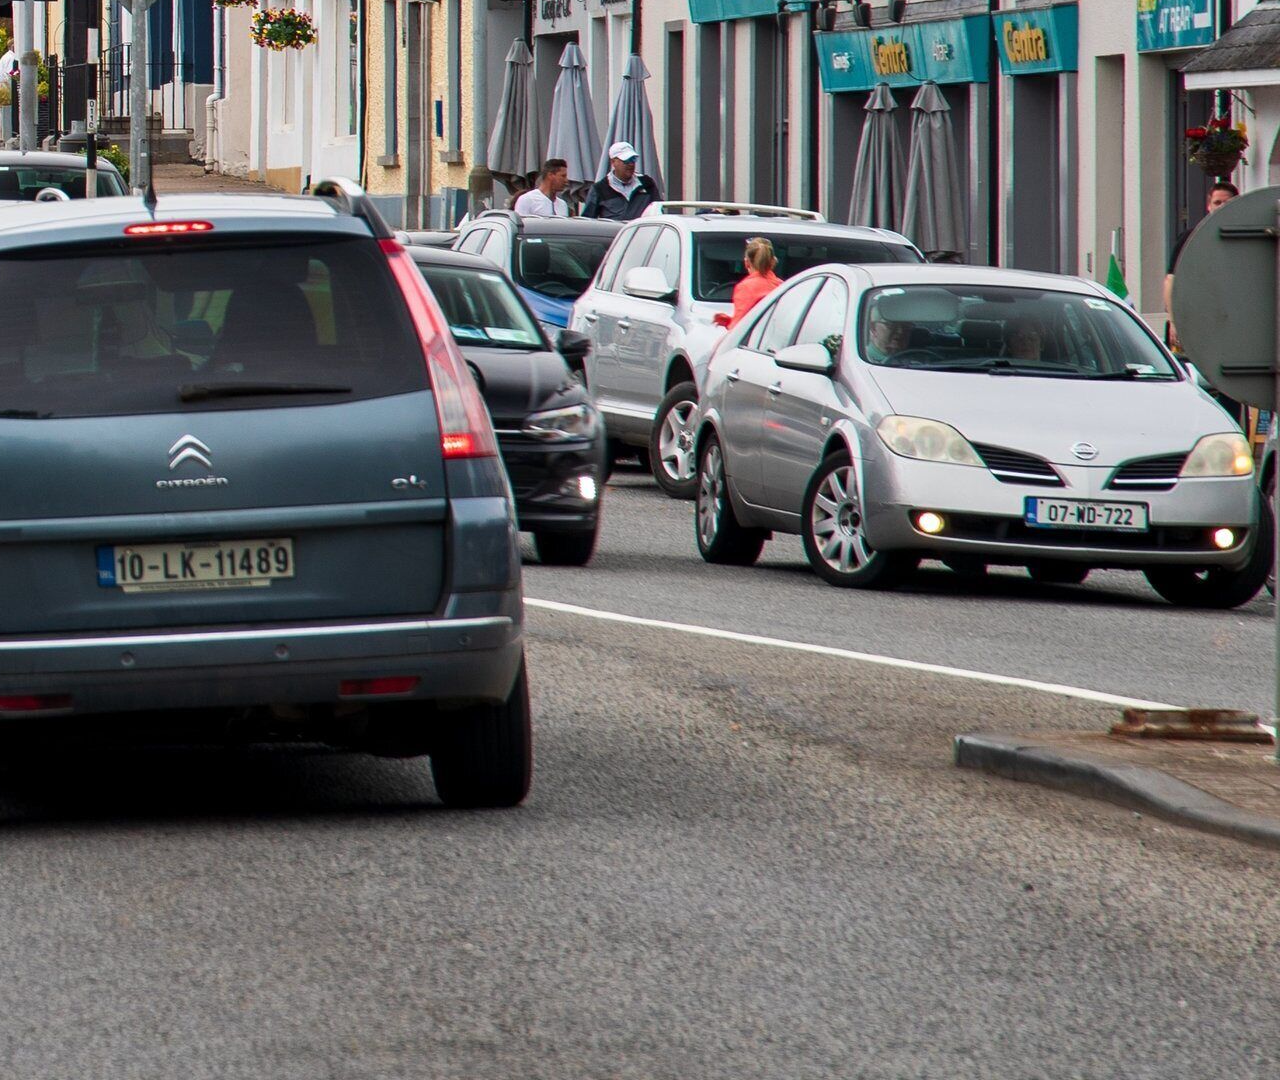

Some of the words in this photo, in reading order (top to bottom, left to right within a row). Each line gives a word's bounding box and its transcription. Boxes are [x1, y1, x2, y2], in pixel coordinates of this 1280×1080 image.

[1159, 7, 1169, 33] AT
[1170, 5, 1191, 32] REAR
[872, 36, 908, 76] Centra
[1003, 21, 1048, 65] Centra
[117, 546, 289, 581] 10-LK-11489
